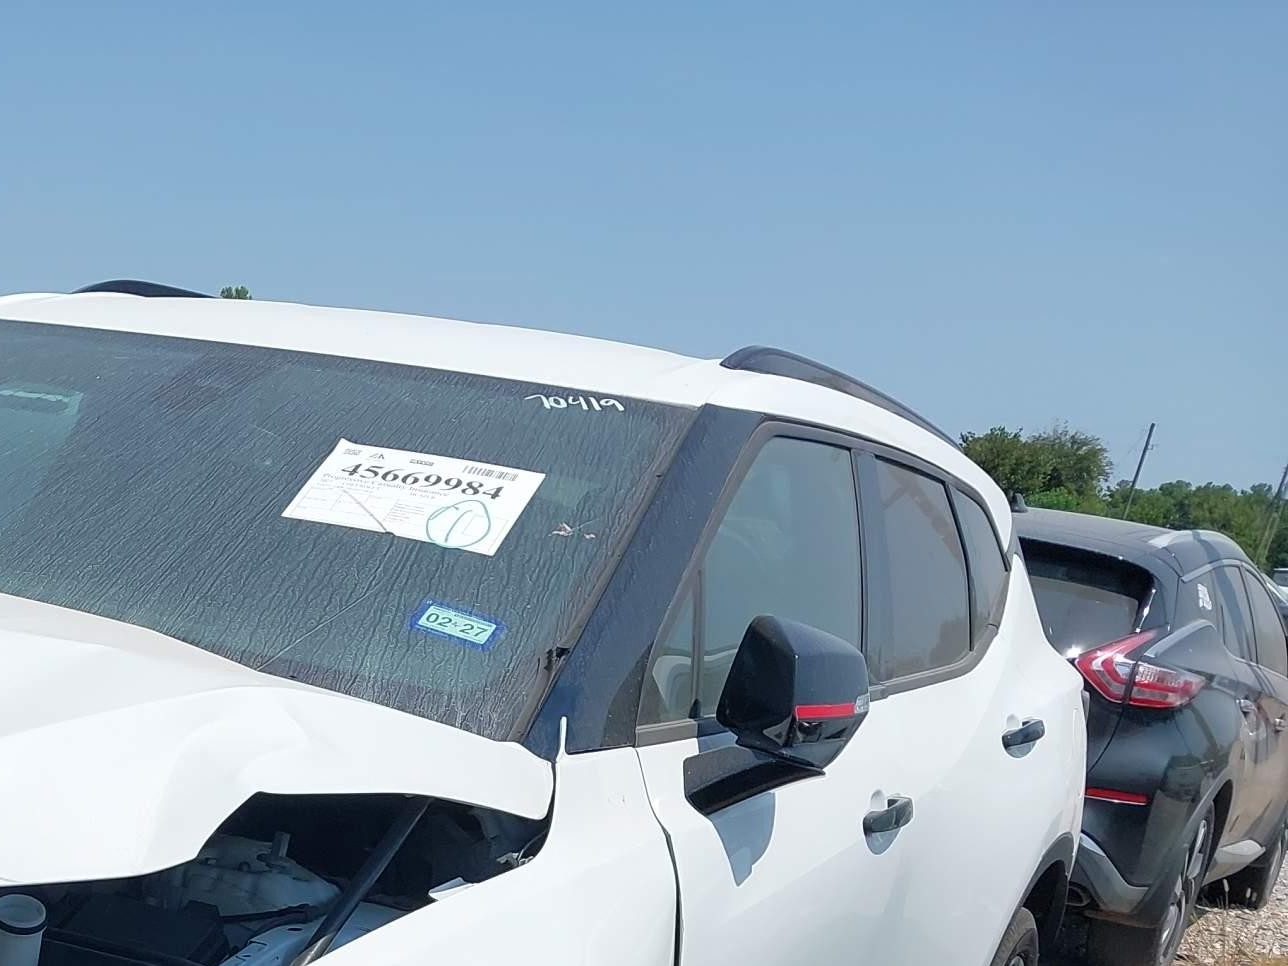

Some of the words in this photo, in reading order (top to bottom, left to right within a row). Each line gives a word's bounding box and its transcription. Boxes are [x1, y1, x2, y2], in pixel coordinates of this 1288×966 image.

[524, 394, 625, 412] 70419
[341, 463, 505, 500] 45669984
[426, 612, 453, 628] 02
[459, 623, 488, 637] 27
